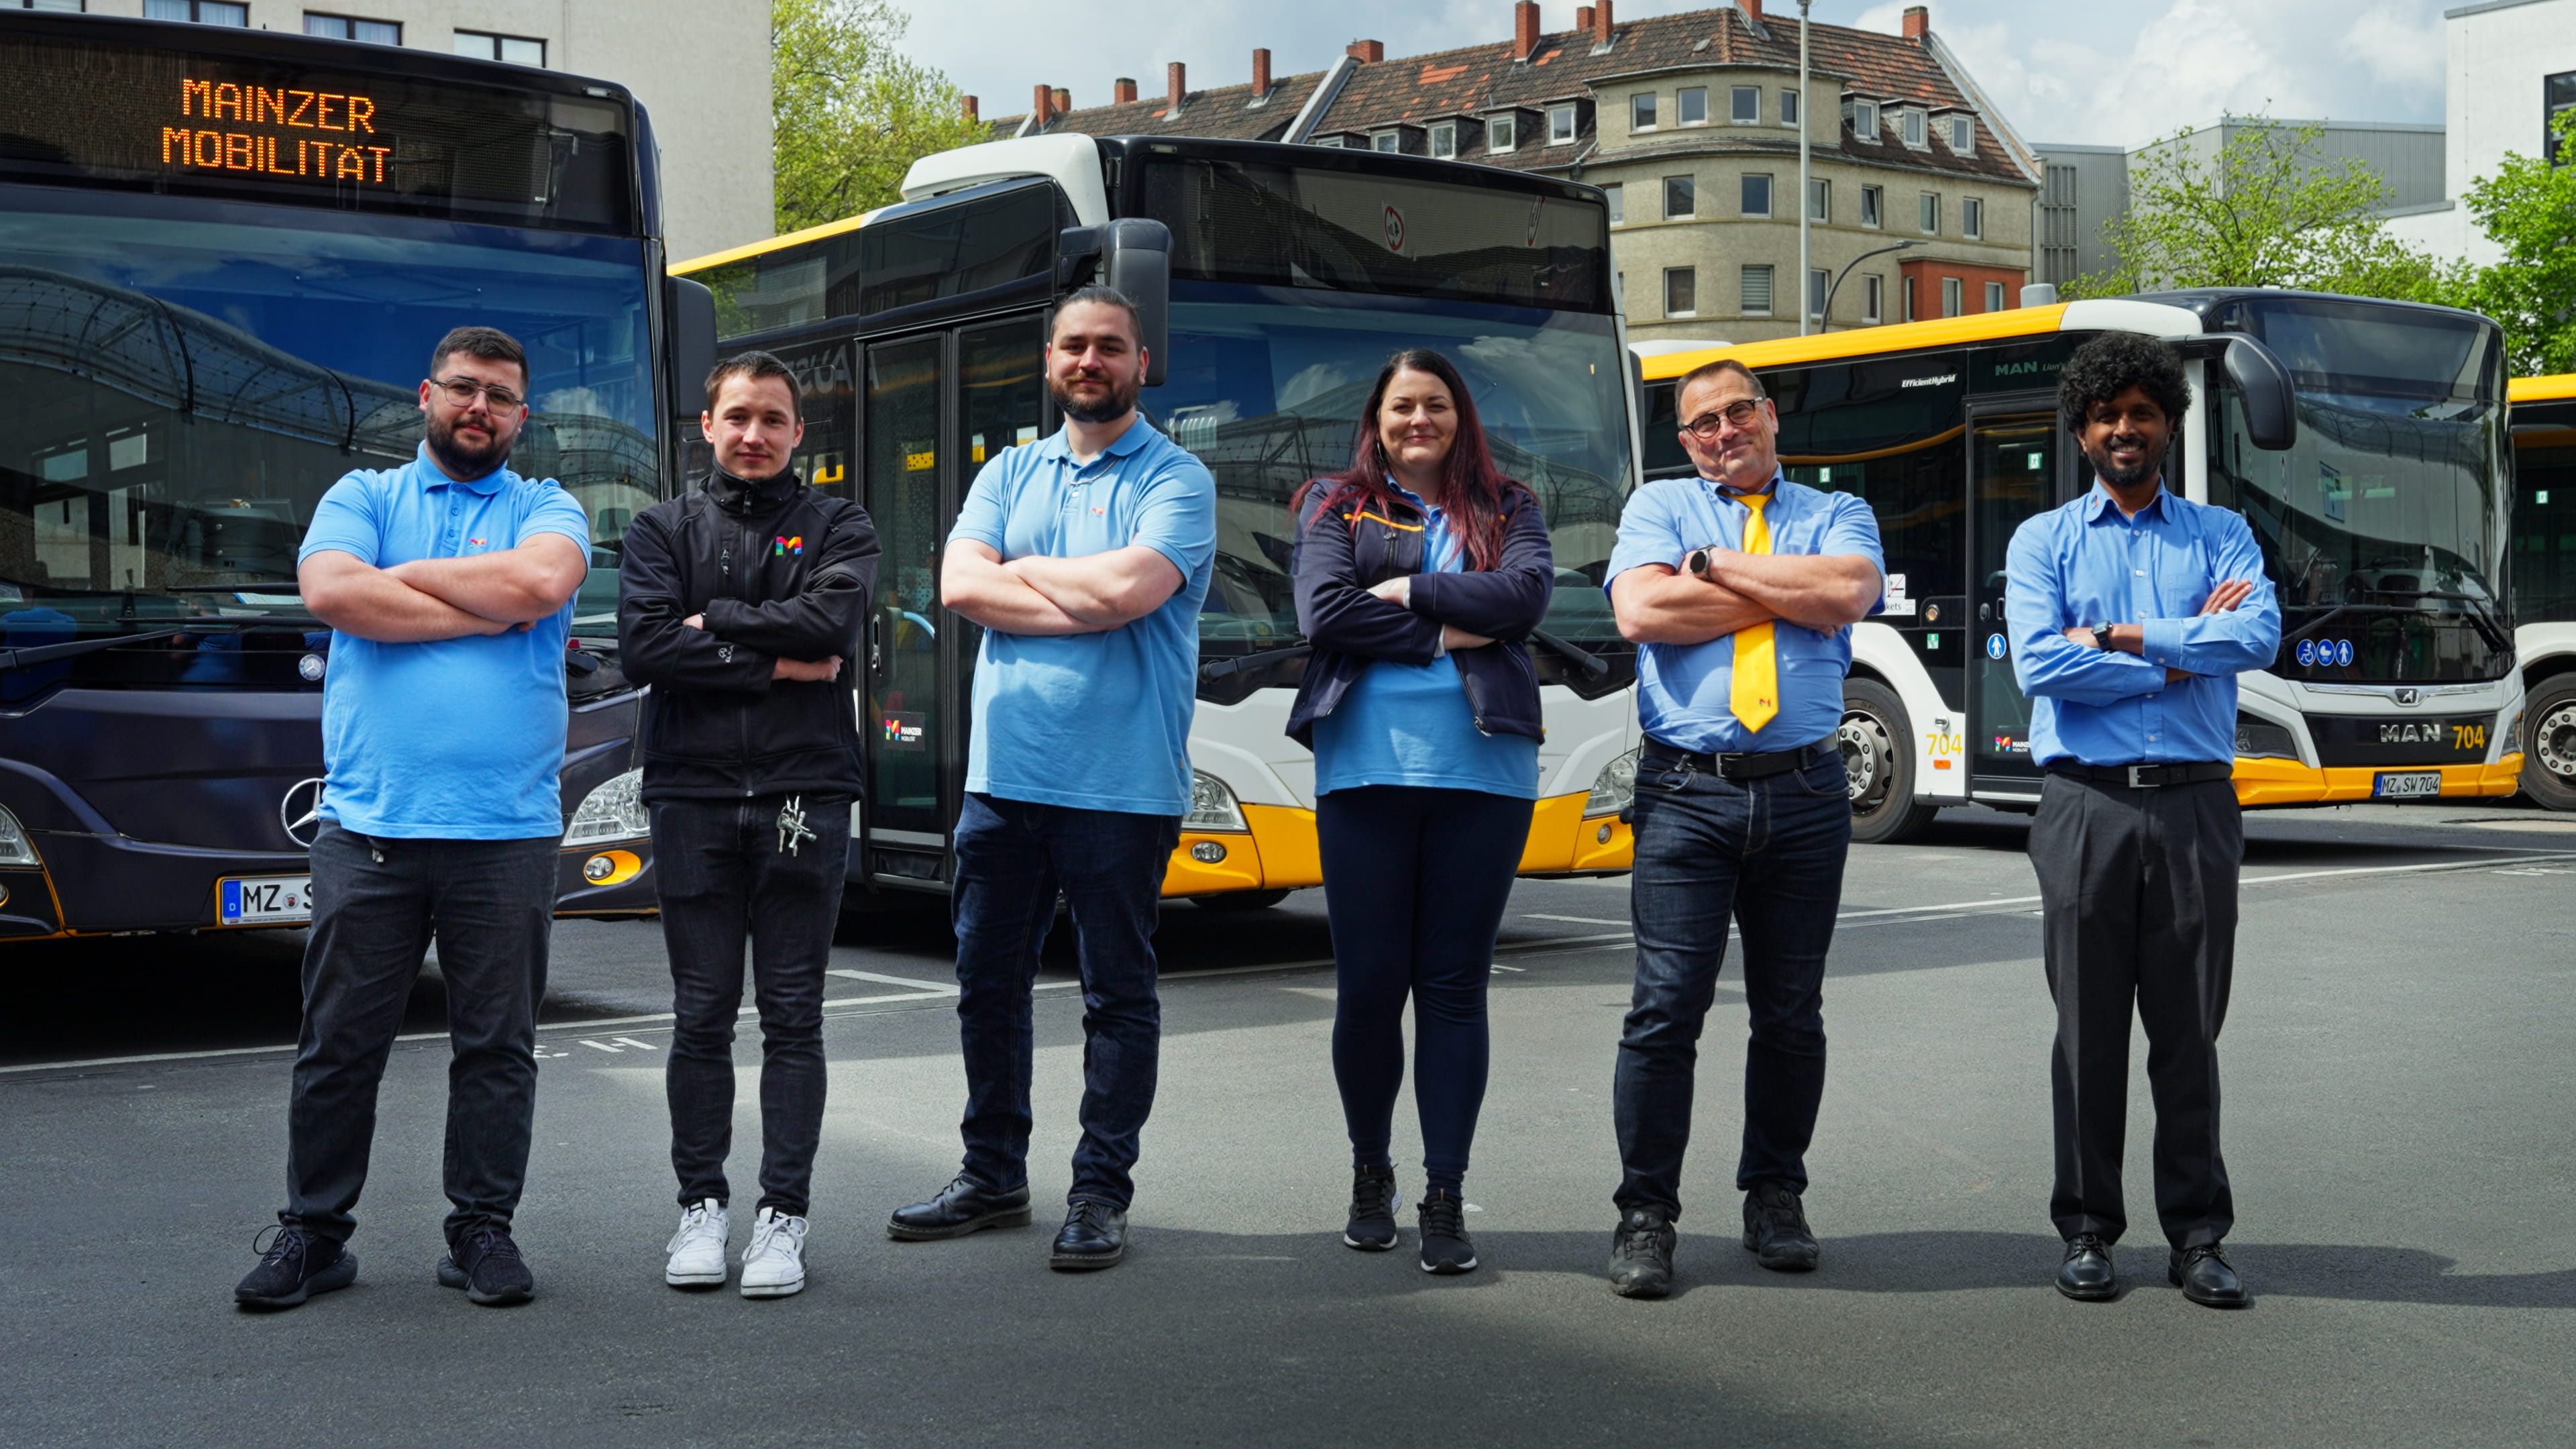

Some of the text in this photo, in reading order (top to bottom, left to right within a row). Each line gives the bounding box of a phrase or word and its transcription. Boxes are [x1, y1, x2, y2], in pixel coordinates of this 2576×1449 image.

[182, 78, 375, 133] MAINZER
[163, 127, 390, 182] MOBILITÄT
[1995, 362, 2037, 376] MAN
[1901, 374, 1956, 388] EfficientHybrid
[1926, 733, 1964, 756] 704
[2379, 724, 2441, 743] MAN
[2452, 724, 2485, 749] 704
[2381, 776, 2439, 793] MZ SW 704
[243, 883, 282, 914] MZ
